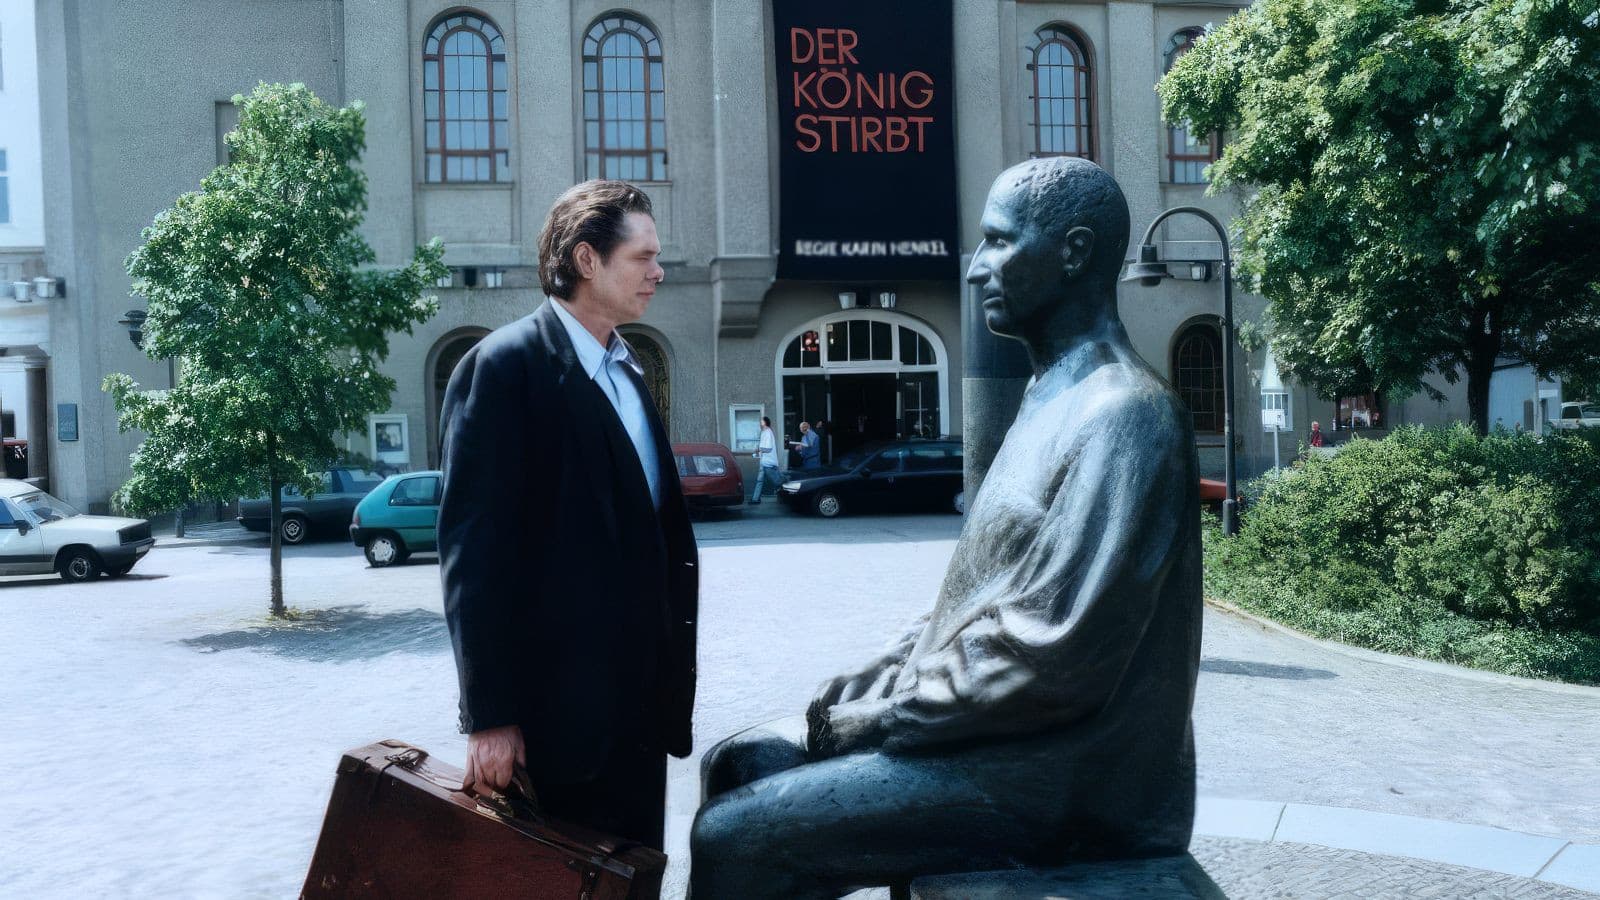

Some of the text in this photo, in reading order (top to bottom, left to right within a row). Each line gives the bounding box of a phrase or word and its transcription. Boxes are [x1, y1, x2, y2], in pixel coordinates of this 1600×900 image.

[791, 27, 859, 65] DER
[793, 67, 934, 109] KÖNIG
[795, 114, 934, 153] STIRBT
